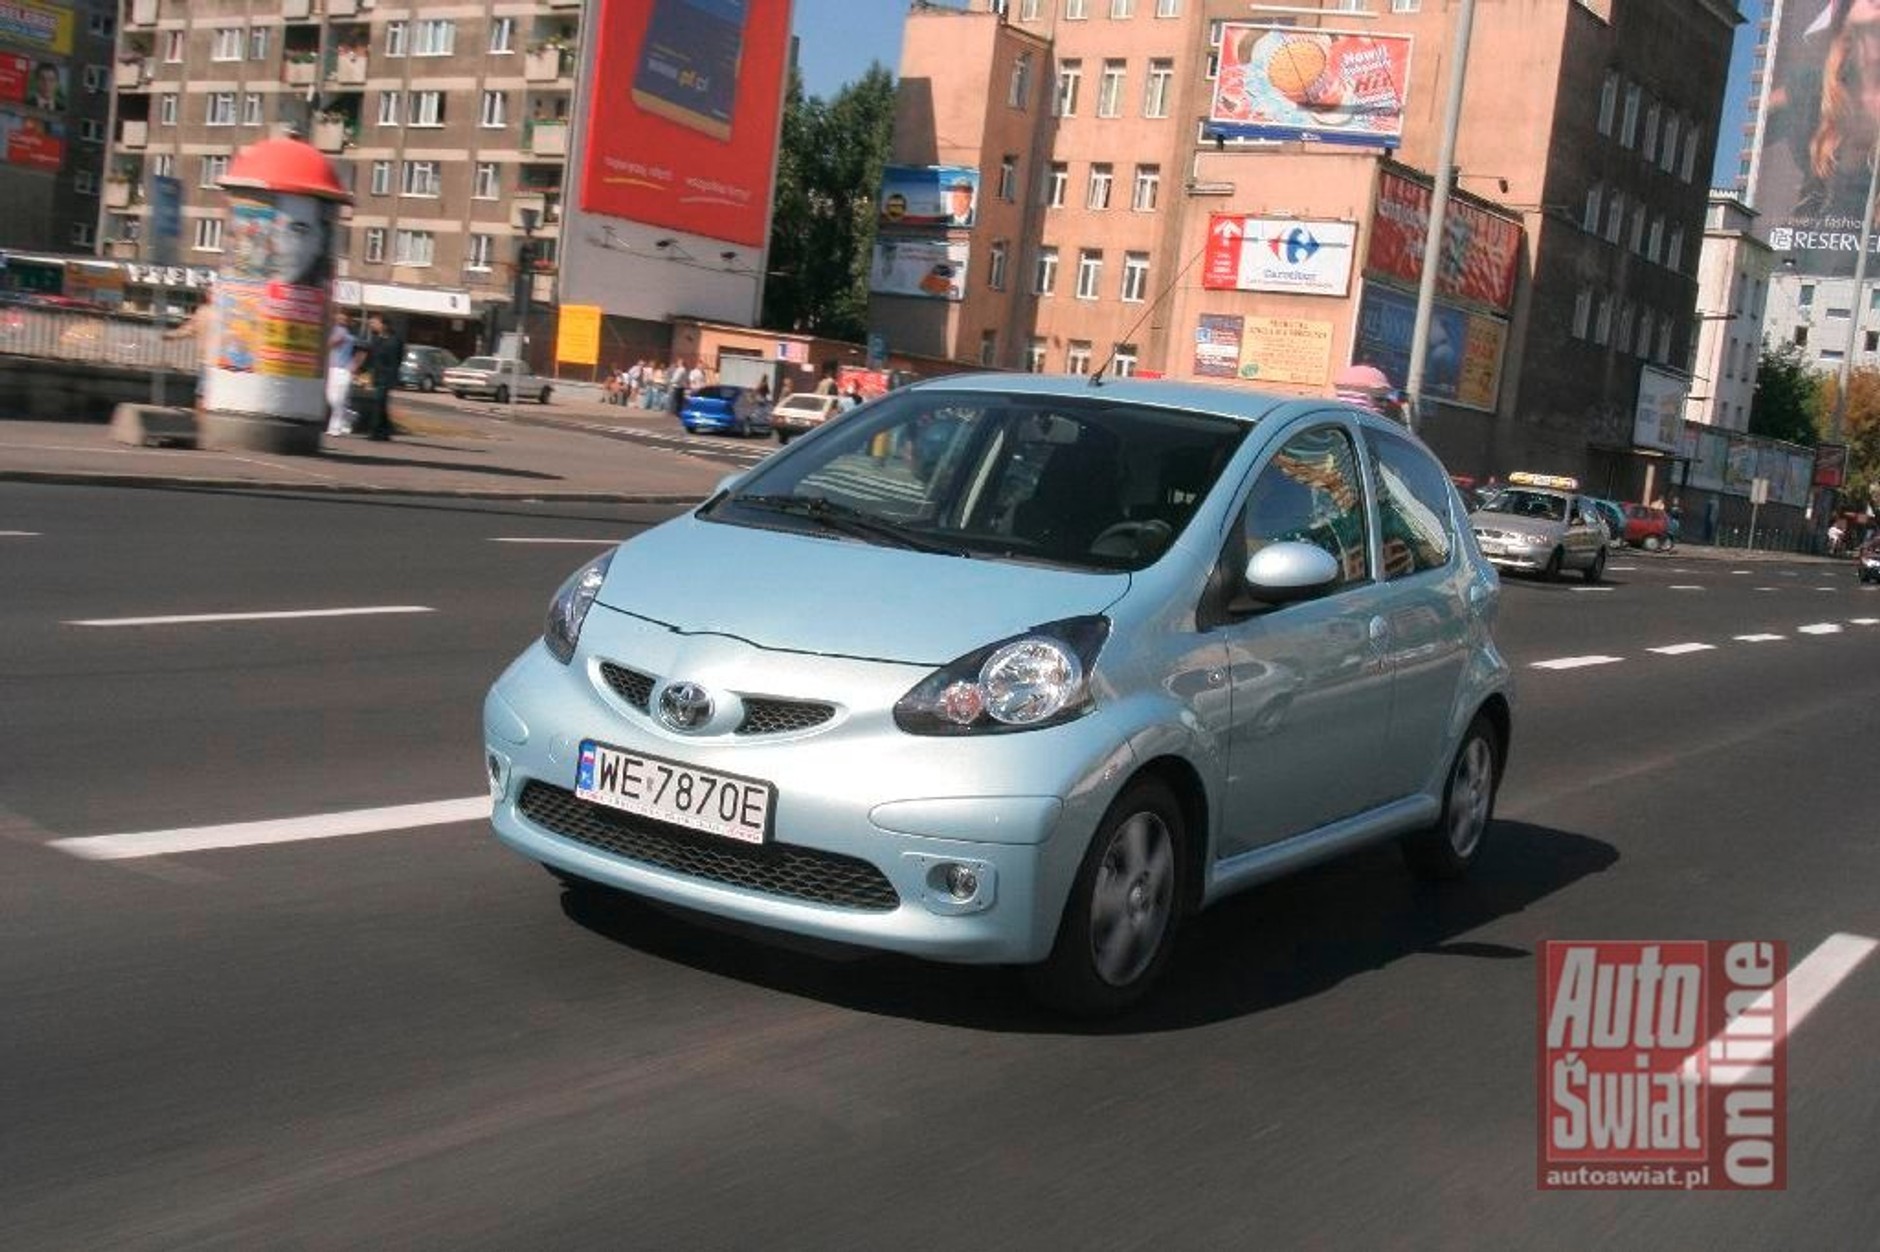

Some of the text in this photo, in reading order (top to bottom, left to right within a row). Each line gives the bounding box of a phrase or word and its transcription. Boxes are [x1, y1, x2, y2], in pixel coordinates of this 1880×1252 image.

[1794, 230, 1880, 253] RESERVE
[600, 752, 644, 799] WE
[653, 765, 766, 829] 7870E
